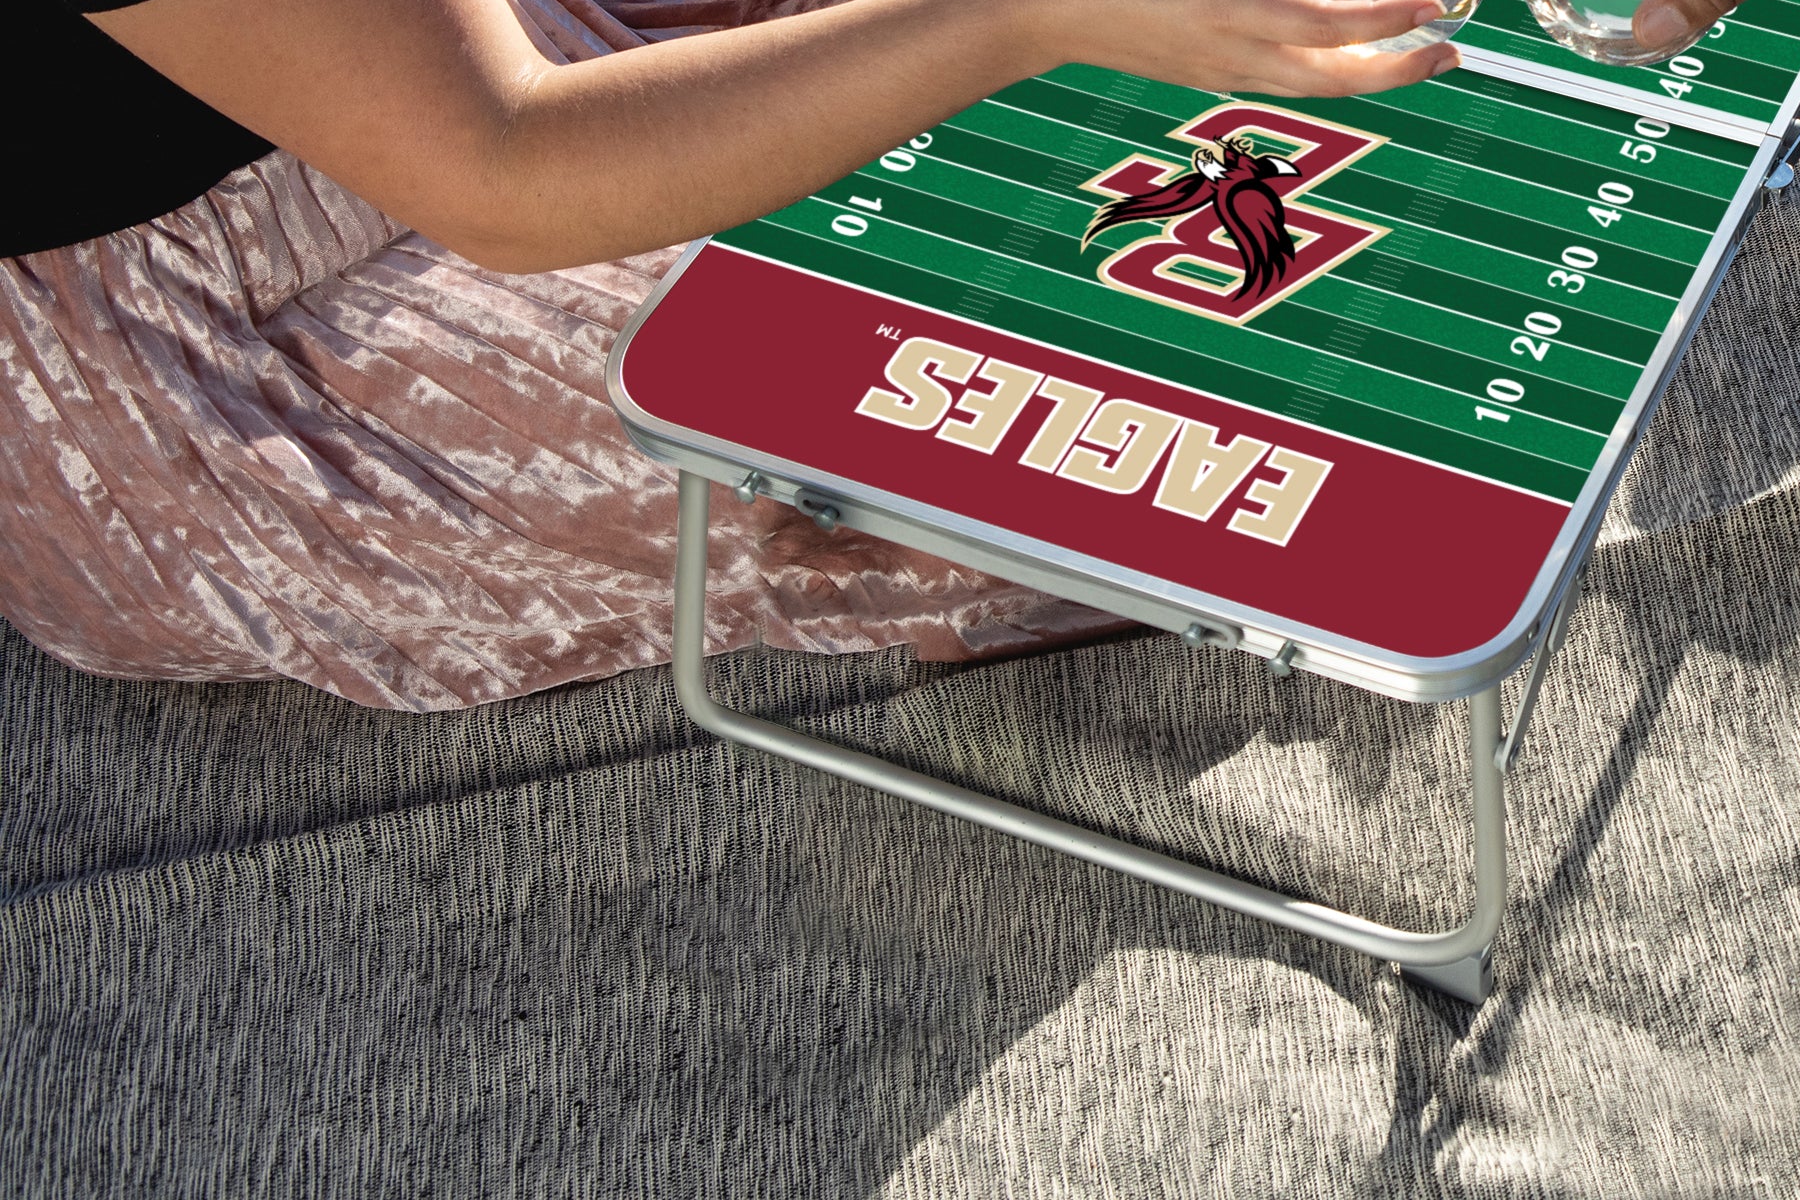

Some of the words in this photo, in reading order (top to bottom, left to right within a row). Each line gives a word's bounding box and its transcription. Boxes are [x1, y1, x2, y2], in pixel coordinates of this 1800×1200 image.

[1658, 54, 1705, 100] 40
[1619, 117, 1672, 164] 50
[831, 195, 883, 237] 10
[1586, 181, 1635, 229] 40
[1547, 245, 1599, 294] 30
[1510, 310, 1563, 361] 20
[1474, 377, 1526, 423] 10
[853, 336, 1336, 548] EAGLES
